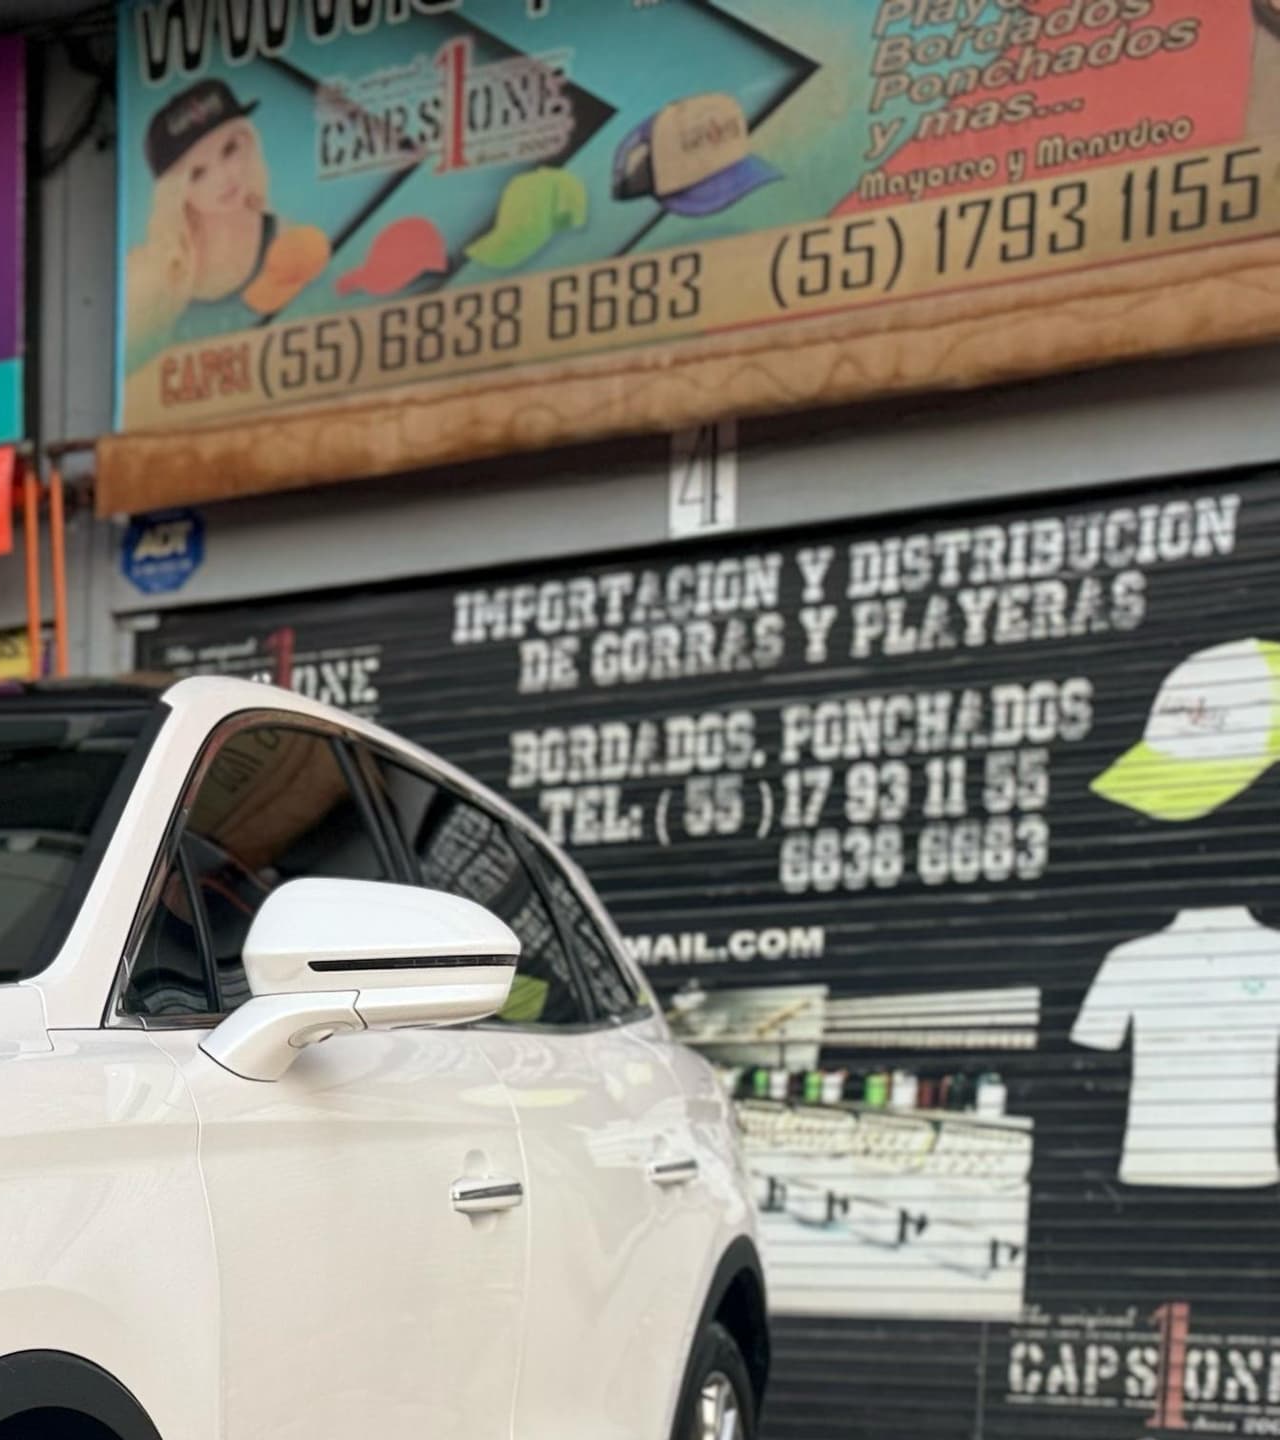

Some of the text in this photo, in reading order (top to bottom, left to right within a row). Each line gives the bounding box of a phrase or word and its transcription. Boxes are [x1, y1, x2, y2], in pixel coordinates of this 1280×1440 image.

[868, 18, 1200, 113] Ponchados
[864, 93, 1086, 160] y mas...
[1007, 148, 1027, 182] y
[1038, 114, 1194, 168] Menudeo
[258, 313, 364, 398] (55)
[378, 285, 523, 373] 6838
[548, 252, 702, 342] 6683
[770, 217, 904, 308] (55)
[935, 182, 1087, 274] 1793
[1120, 147, 1262, 244] 1155
[678, 424, 723, 528] 4
[132, 520, 195, 562] ADT
[452, 495, 1240, 646] IMPORTACION Y DISTRIBUCION
[518, 571, 1148, 694] DE GORRAS Y PLAYERAS
[781, 678, 1094, 767] PONCHADOS
[844, 761, 910, 821] 93
[924, 759, 967, 817] 11
[983, 752, 1051, 814] 55
[779, 820, 1050, 893] 6838 6683
